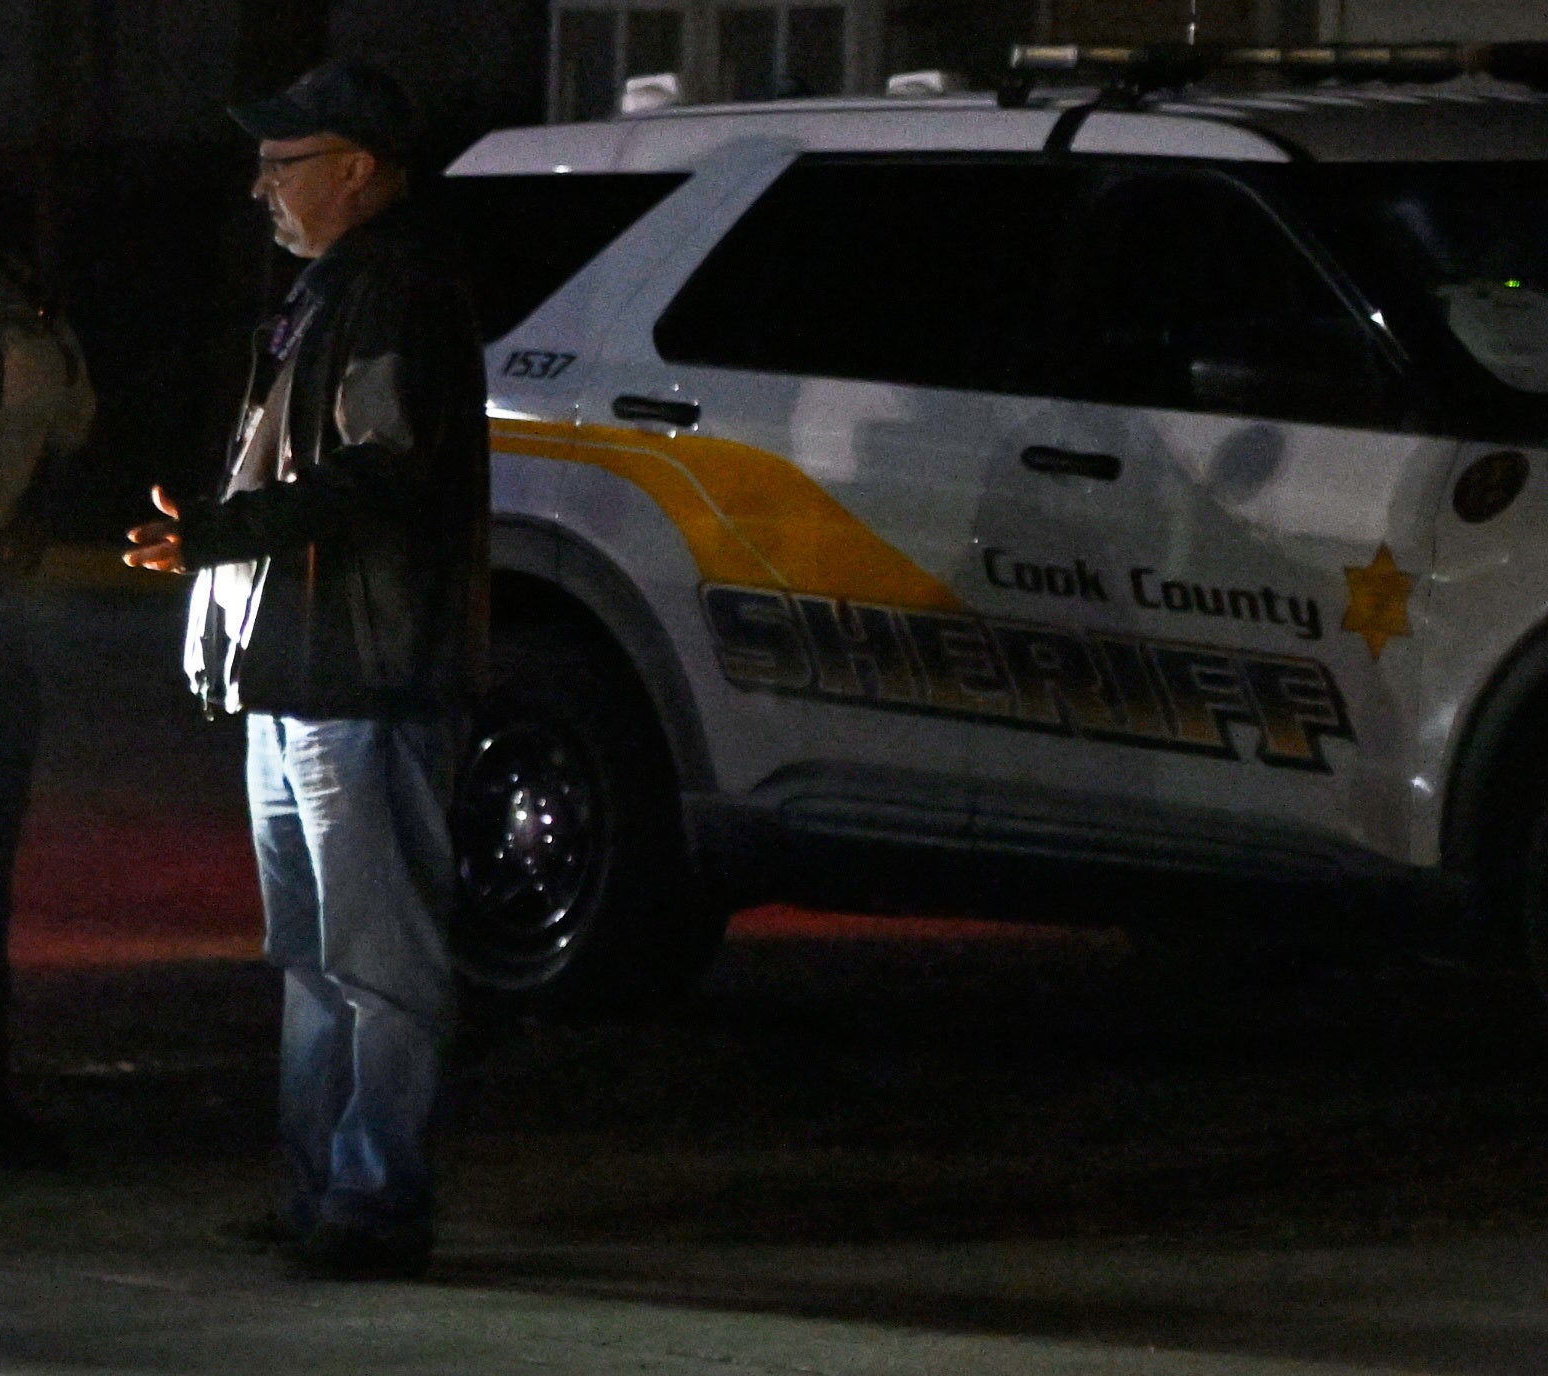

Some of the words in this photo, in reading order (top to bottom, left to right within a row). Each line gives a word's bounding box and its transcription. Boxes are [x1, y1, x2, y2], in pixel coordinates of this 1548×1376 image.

[503, 351, 576, 378] 1537
[983, 547, 1109, 602] Cook
[1130, 567, 1323, 641] County
[698, 578, 1356, 775] SHERIFF
